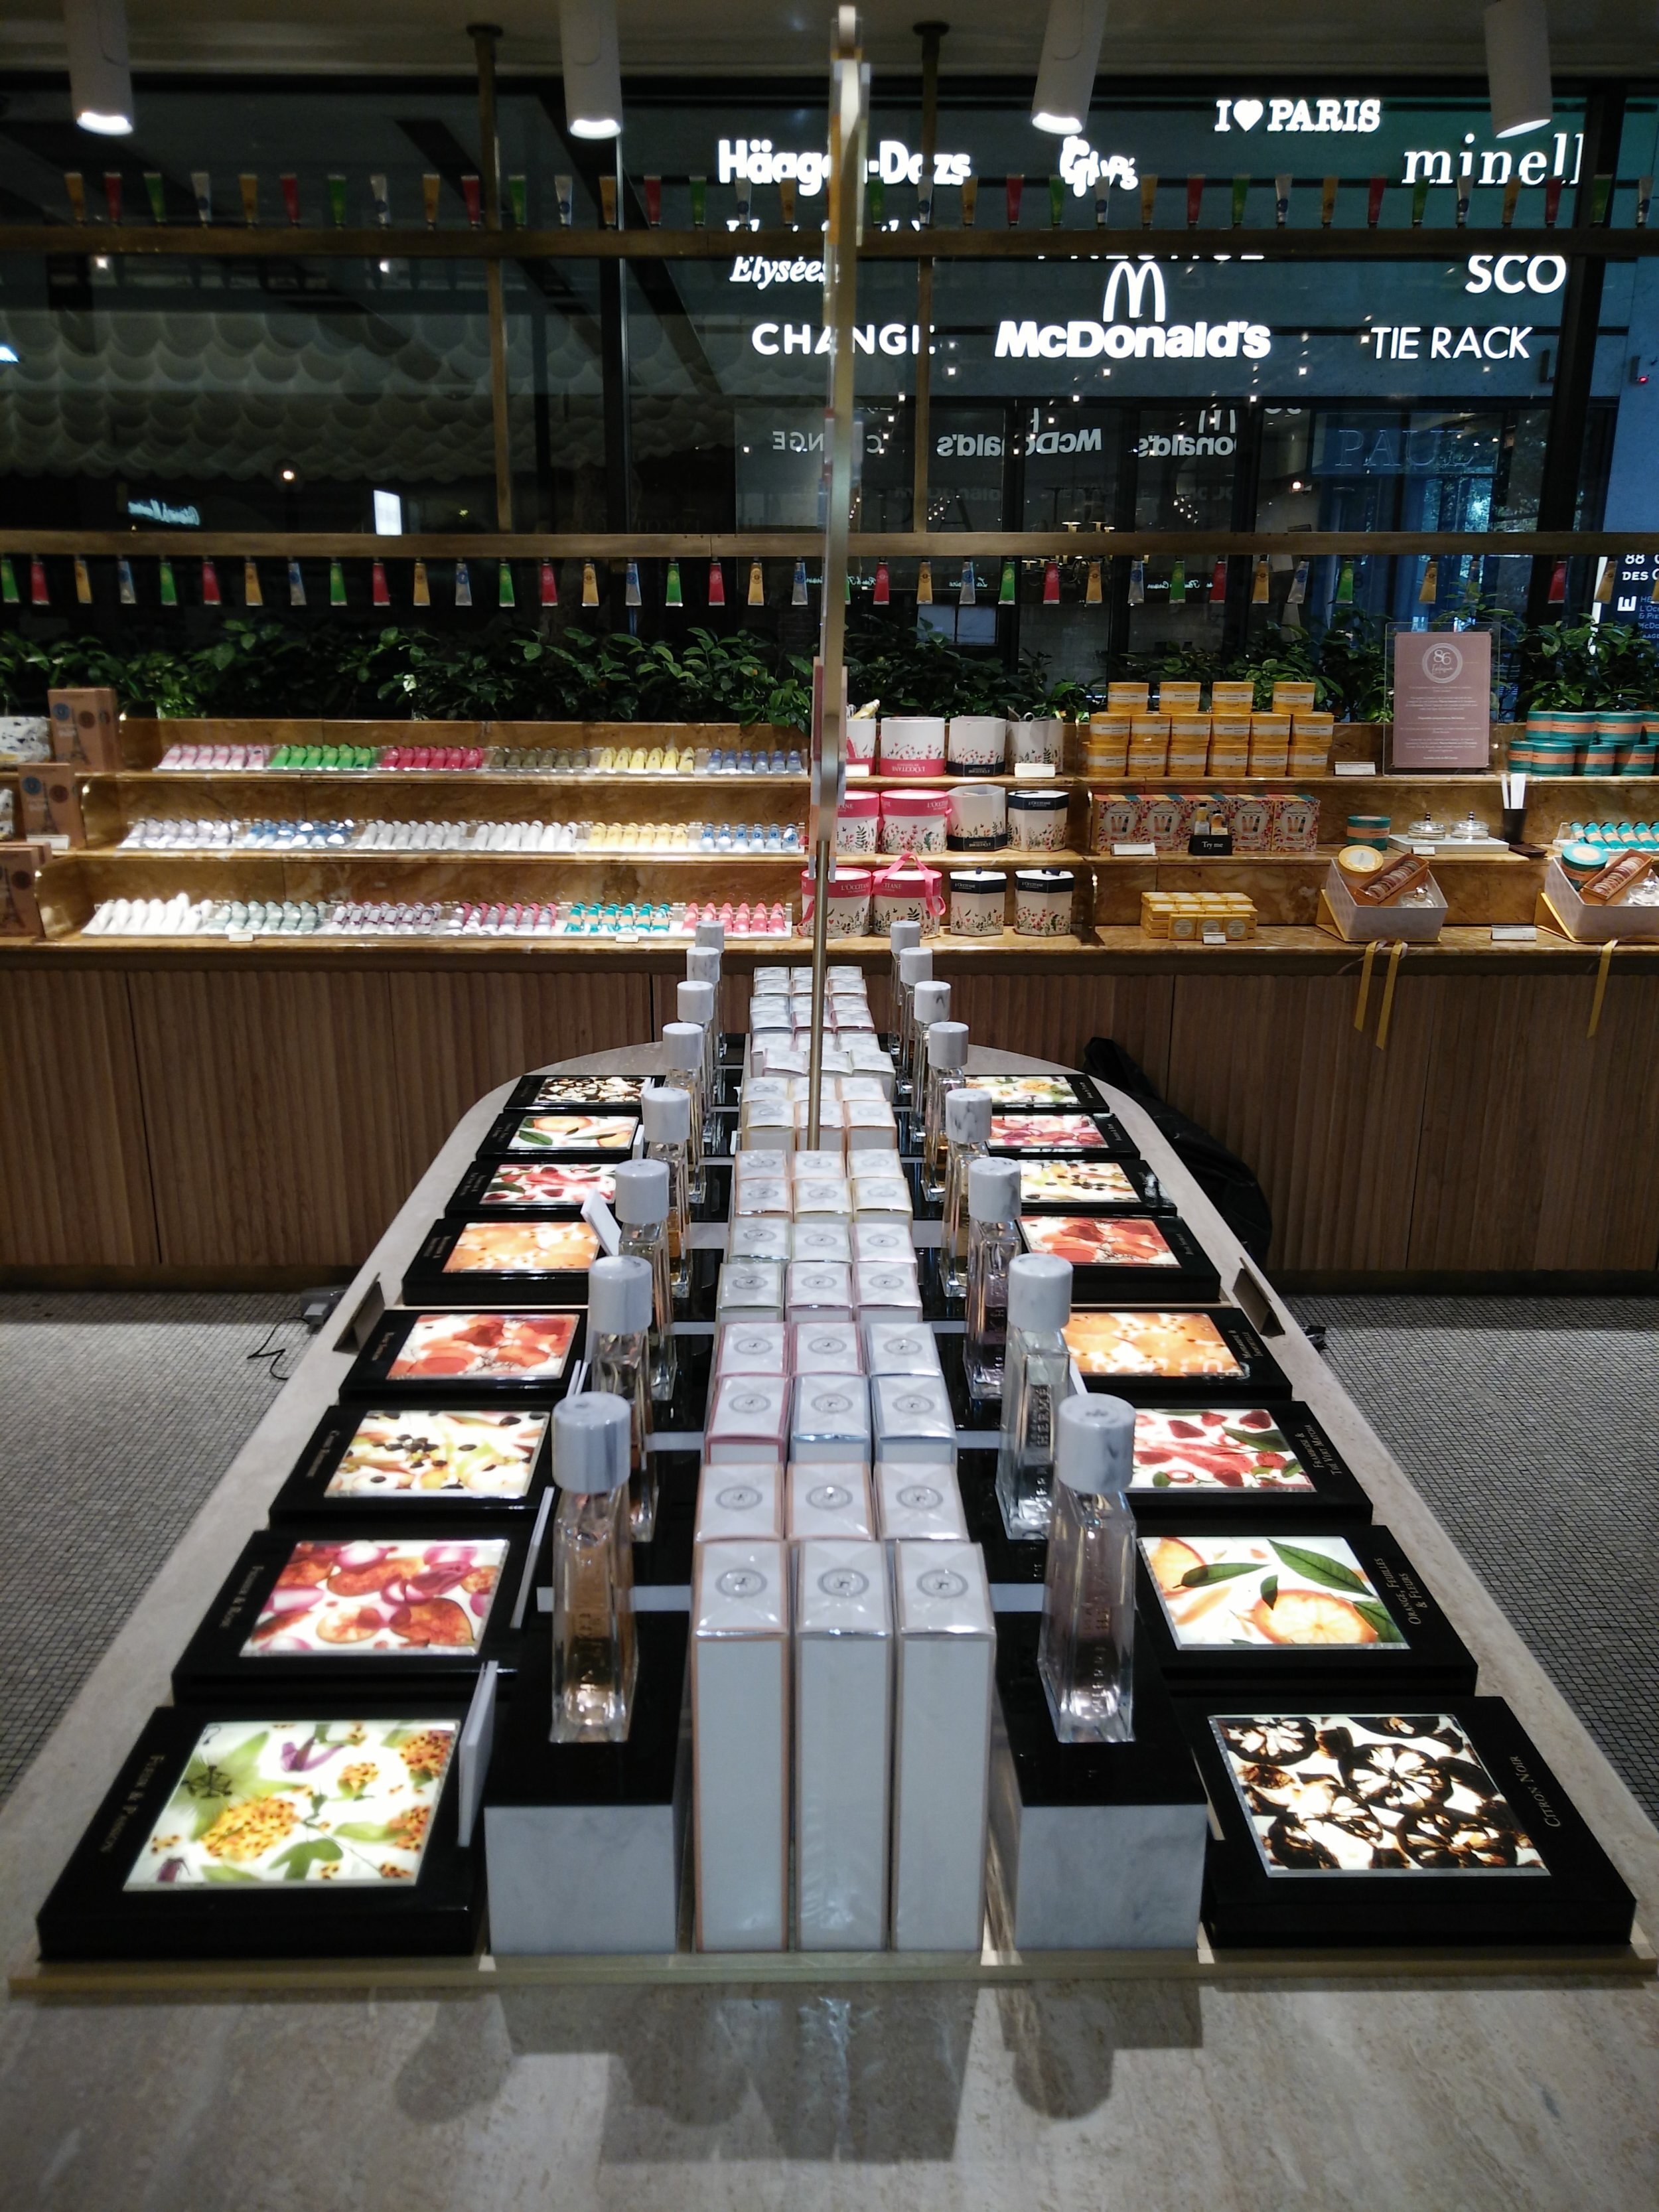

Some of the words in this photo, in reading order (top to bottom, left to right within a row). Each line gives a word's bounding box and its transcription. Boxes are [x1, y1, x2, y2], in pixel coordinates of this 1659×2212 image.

[1267, 100, 1381, 132] PARIS
[717, 139, 971, 196] Häag-Dazs
[995, 321, 1271, 359] McDonald's
[1370, 327, 1419, 359] TIE
[1431, 327, 1533, 359] RACK
[1622, 571, 1649, 581] DES
[1202, 841, 1213, 849] Try
[1374, 1558, 1400, 1589] FEUILLES
[1398, 1573, 1422, 1599] FLEURS
[1510, 1755, 1534, 1783] NOIR
[1528, 1785, 1561, 1827] CITRON
